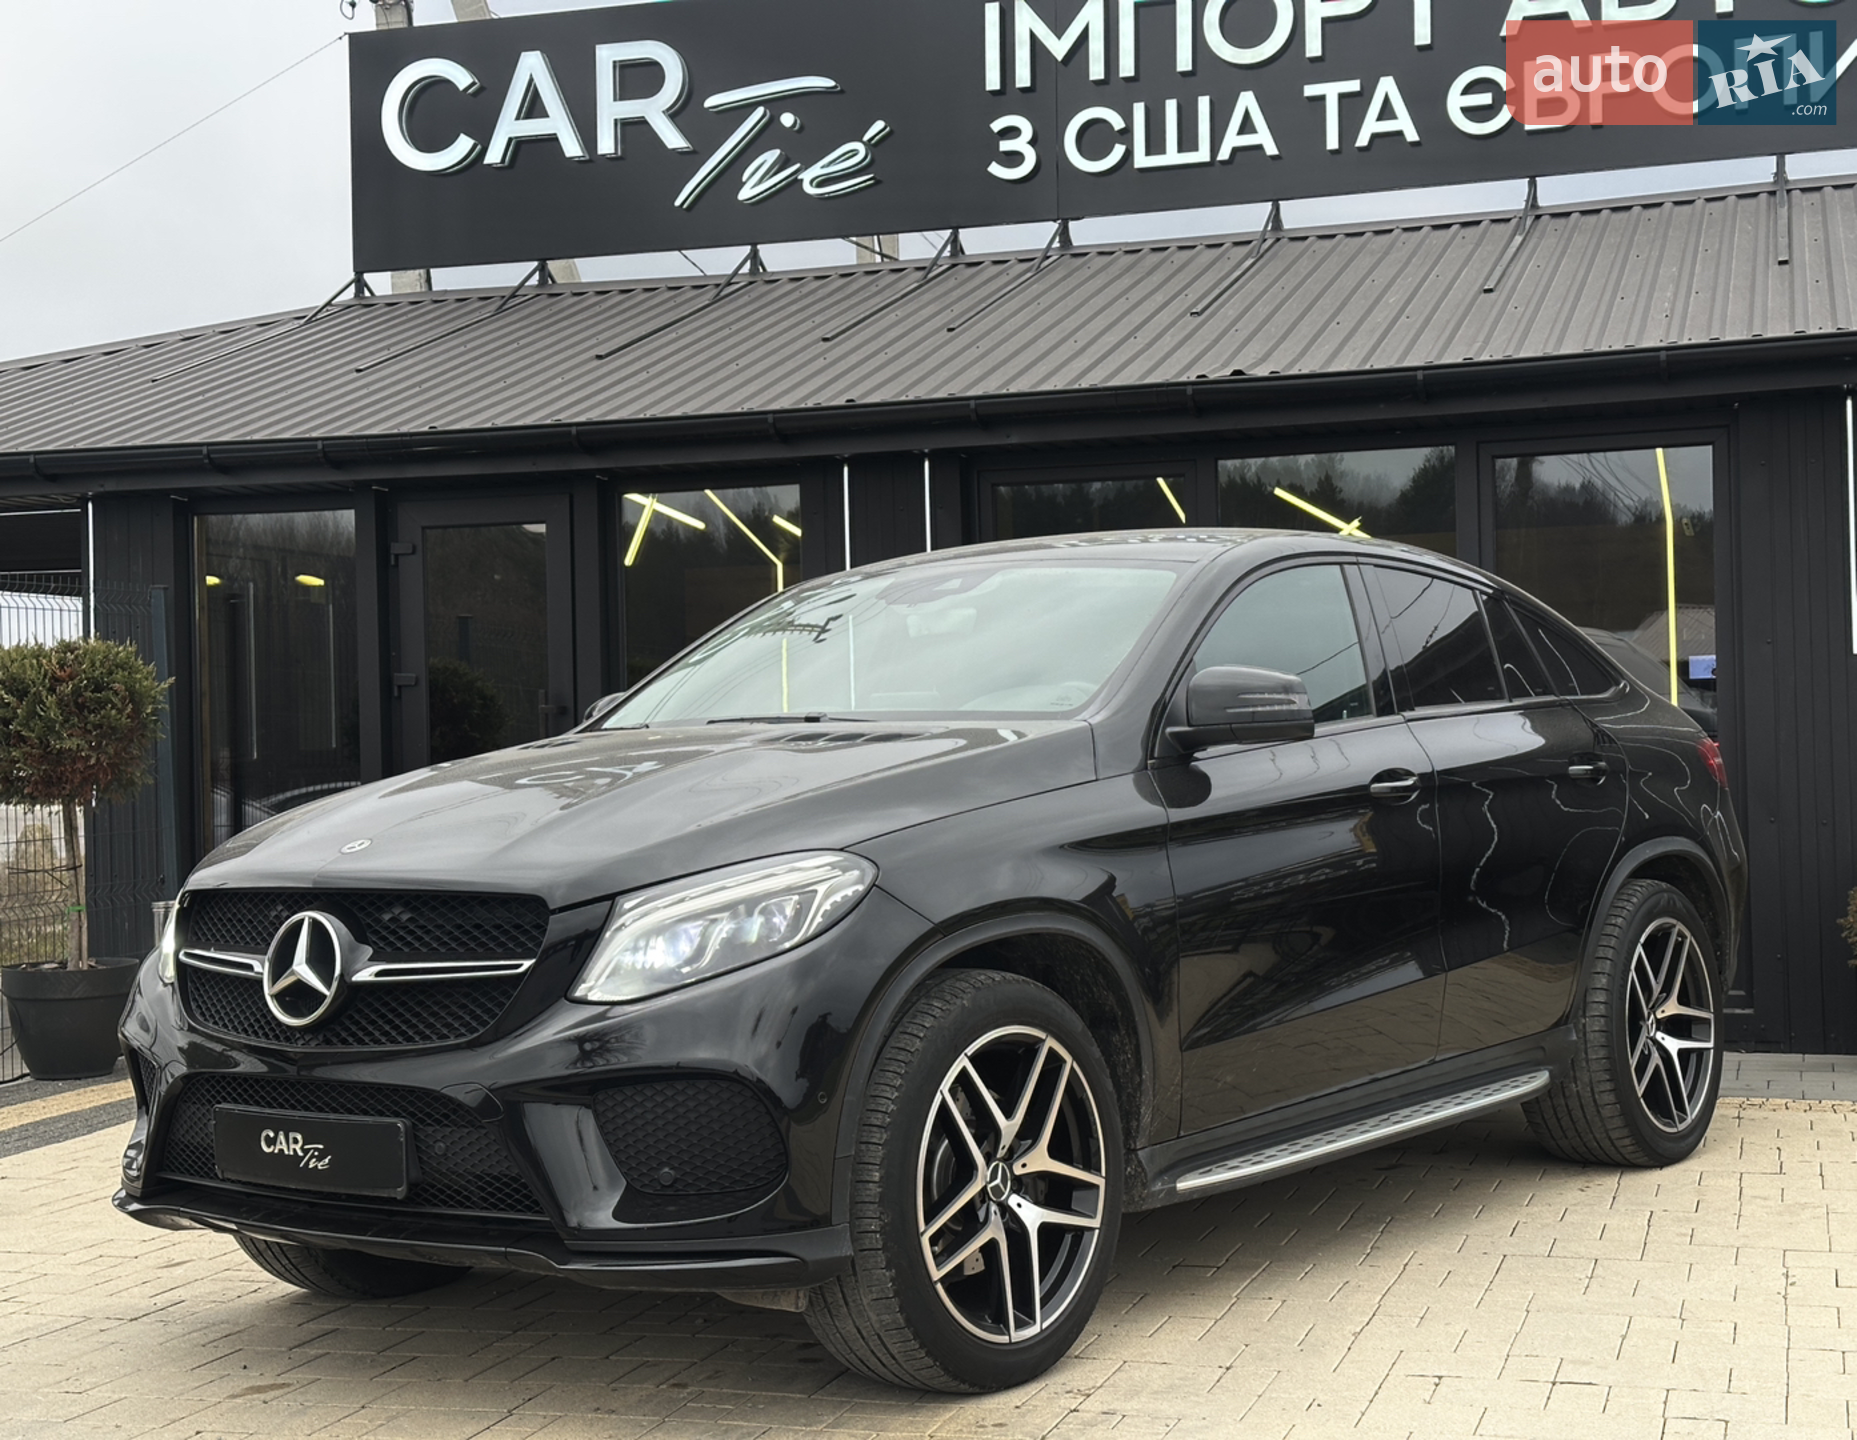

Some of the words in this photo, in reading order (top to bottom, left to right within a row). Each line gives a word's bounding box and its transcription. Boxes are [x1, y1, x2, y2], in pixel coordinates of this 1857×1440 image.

[381, 39, 693, 173] CAR
[1063, 90, 1281, 174] США
[1303, 75, 1422, 152] ТА
[260, 1128, 304, 1157] CAR
